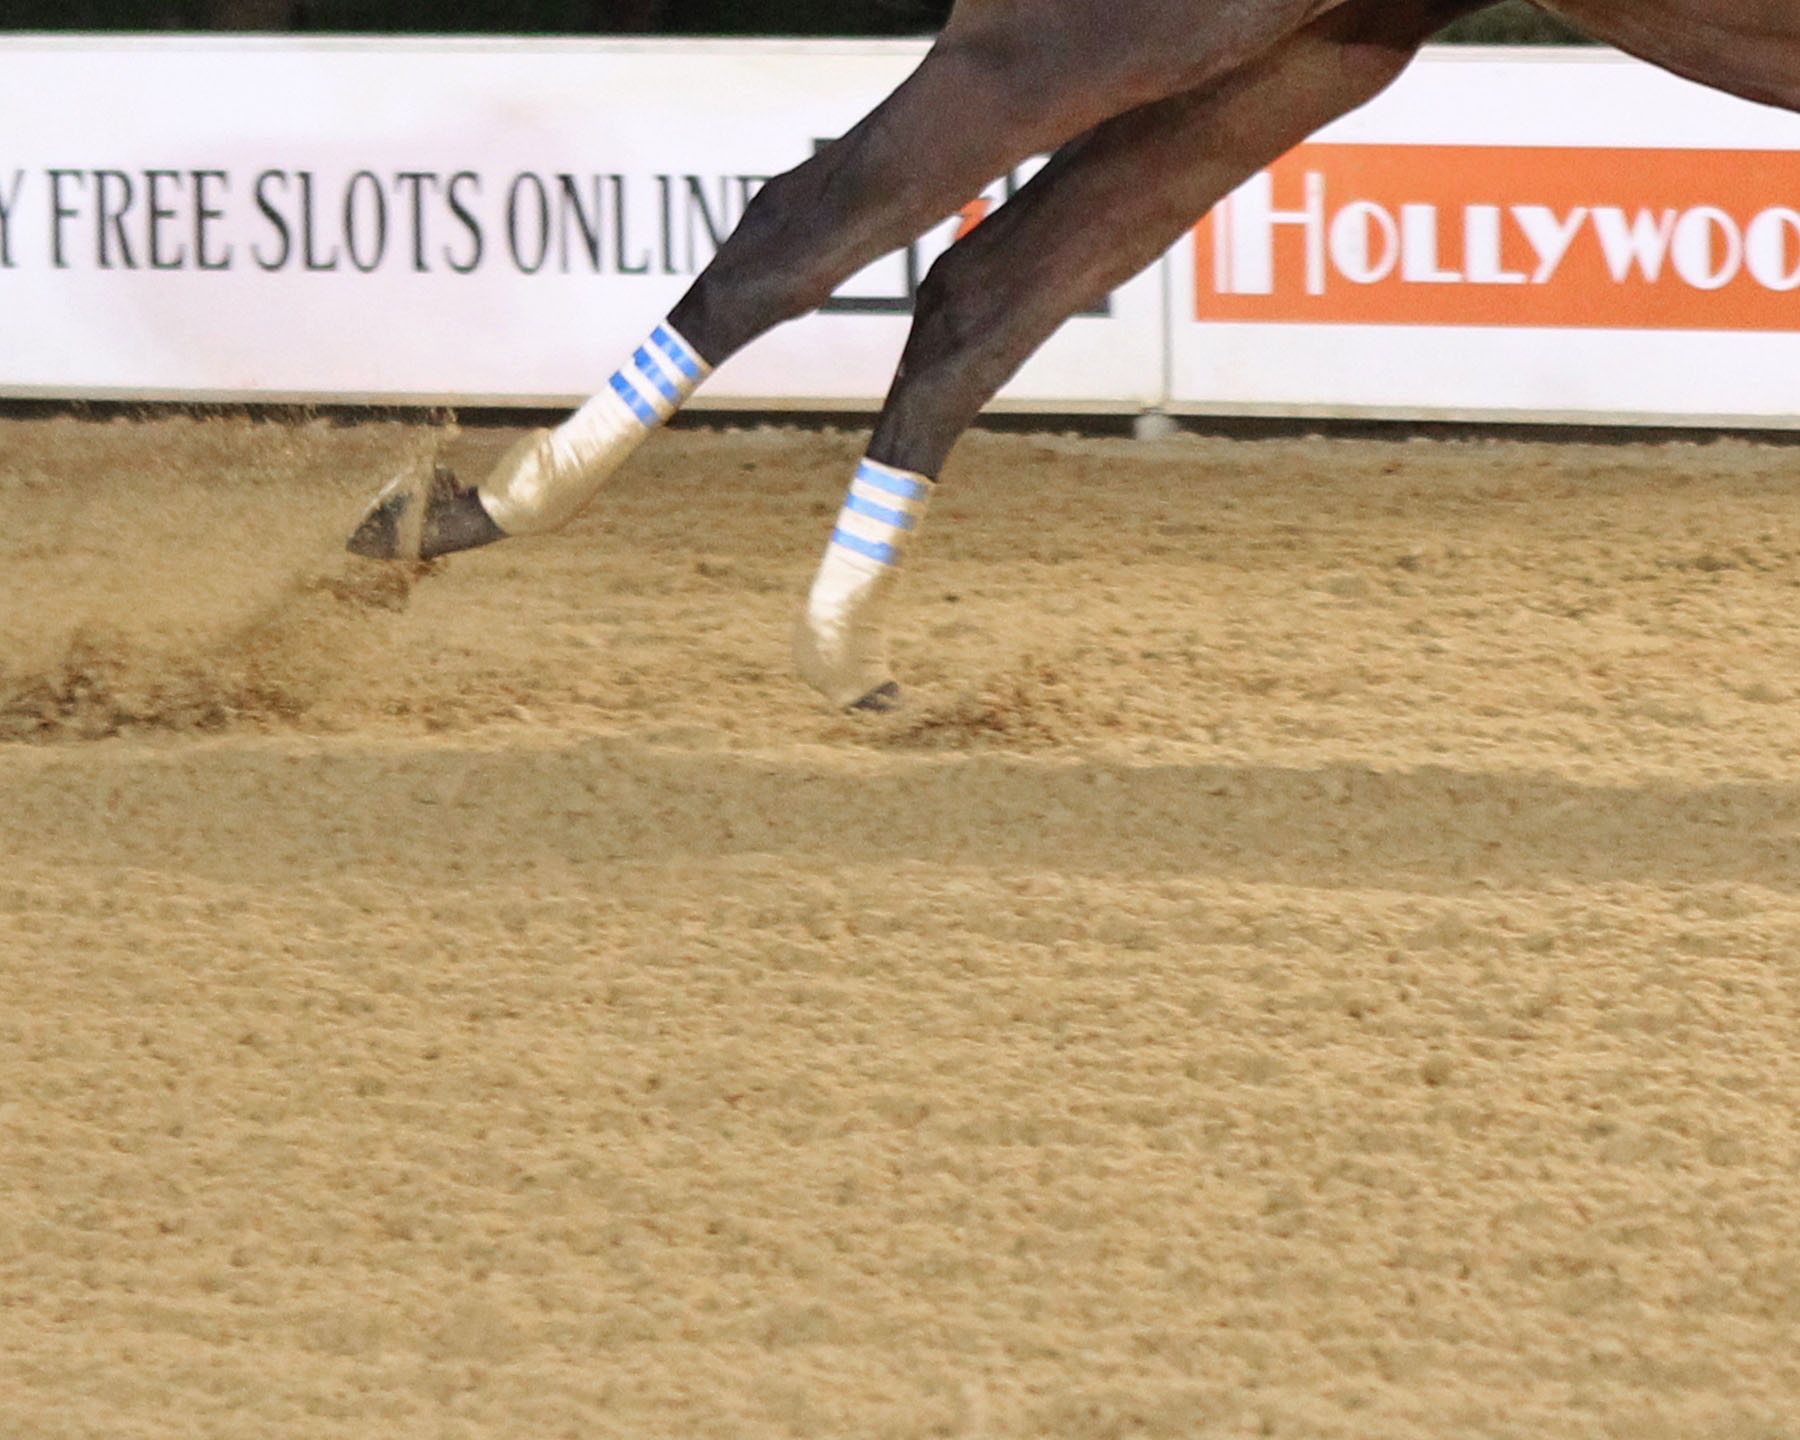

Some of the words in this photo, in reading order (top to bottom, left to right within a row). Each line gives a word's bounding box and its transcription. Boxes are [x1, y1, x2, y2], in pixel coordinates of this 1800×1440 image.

[46, 169, 235, 271] FREE
[251, 169, 485, 274] SLOTS
[507, 171, 775, 275] ONLIN
